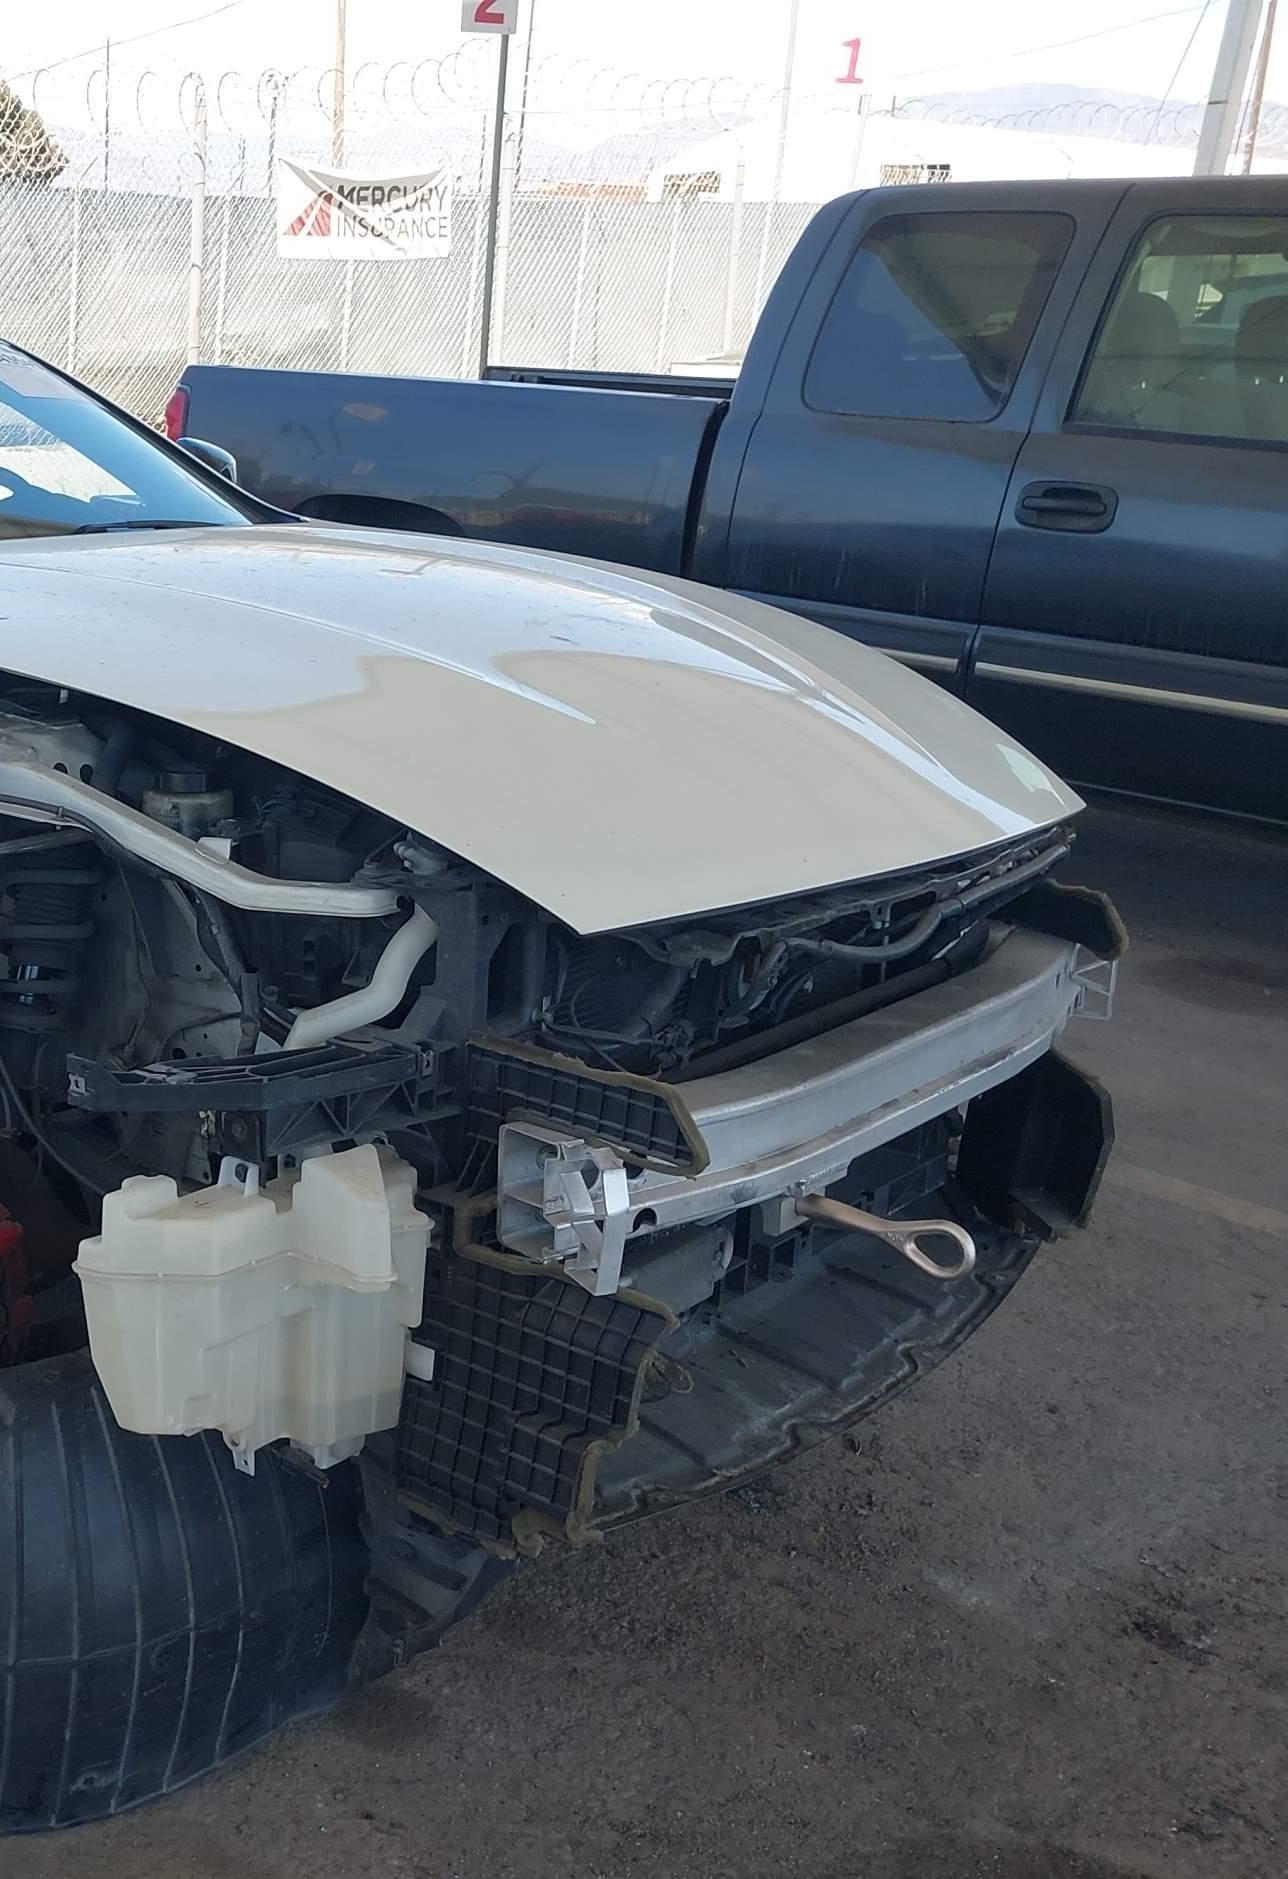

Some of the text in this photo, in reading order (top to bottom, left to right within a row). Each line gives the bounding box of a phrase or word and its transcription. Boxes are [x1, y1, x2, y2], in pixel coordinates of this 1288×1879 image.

[474, 0, 505, 24] 2
[835, 38, 863, 84] 1
[336, 184, 448, 213] MERCURY
[336, 215, 449, 239] INSURANCE
